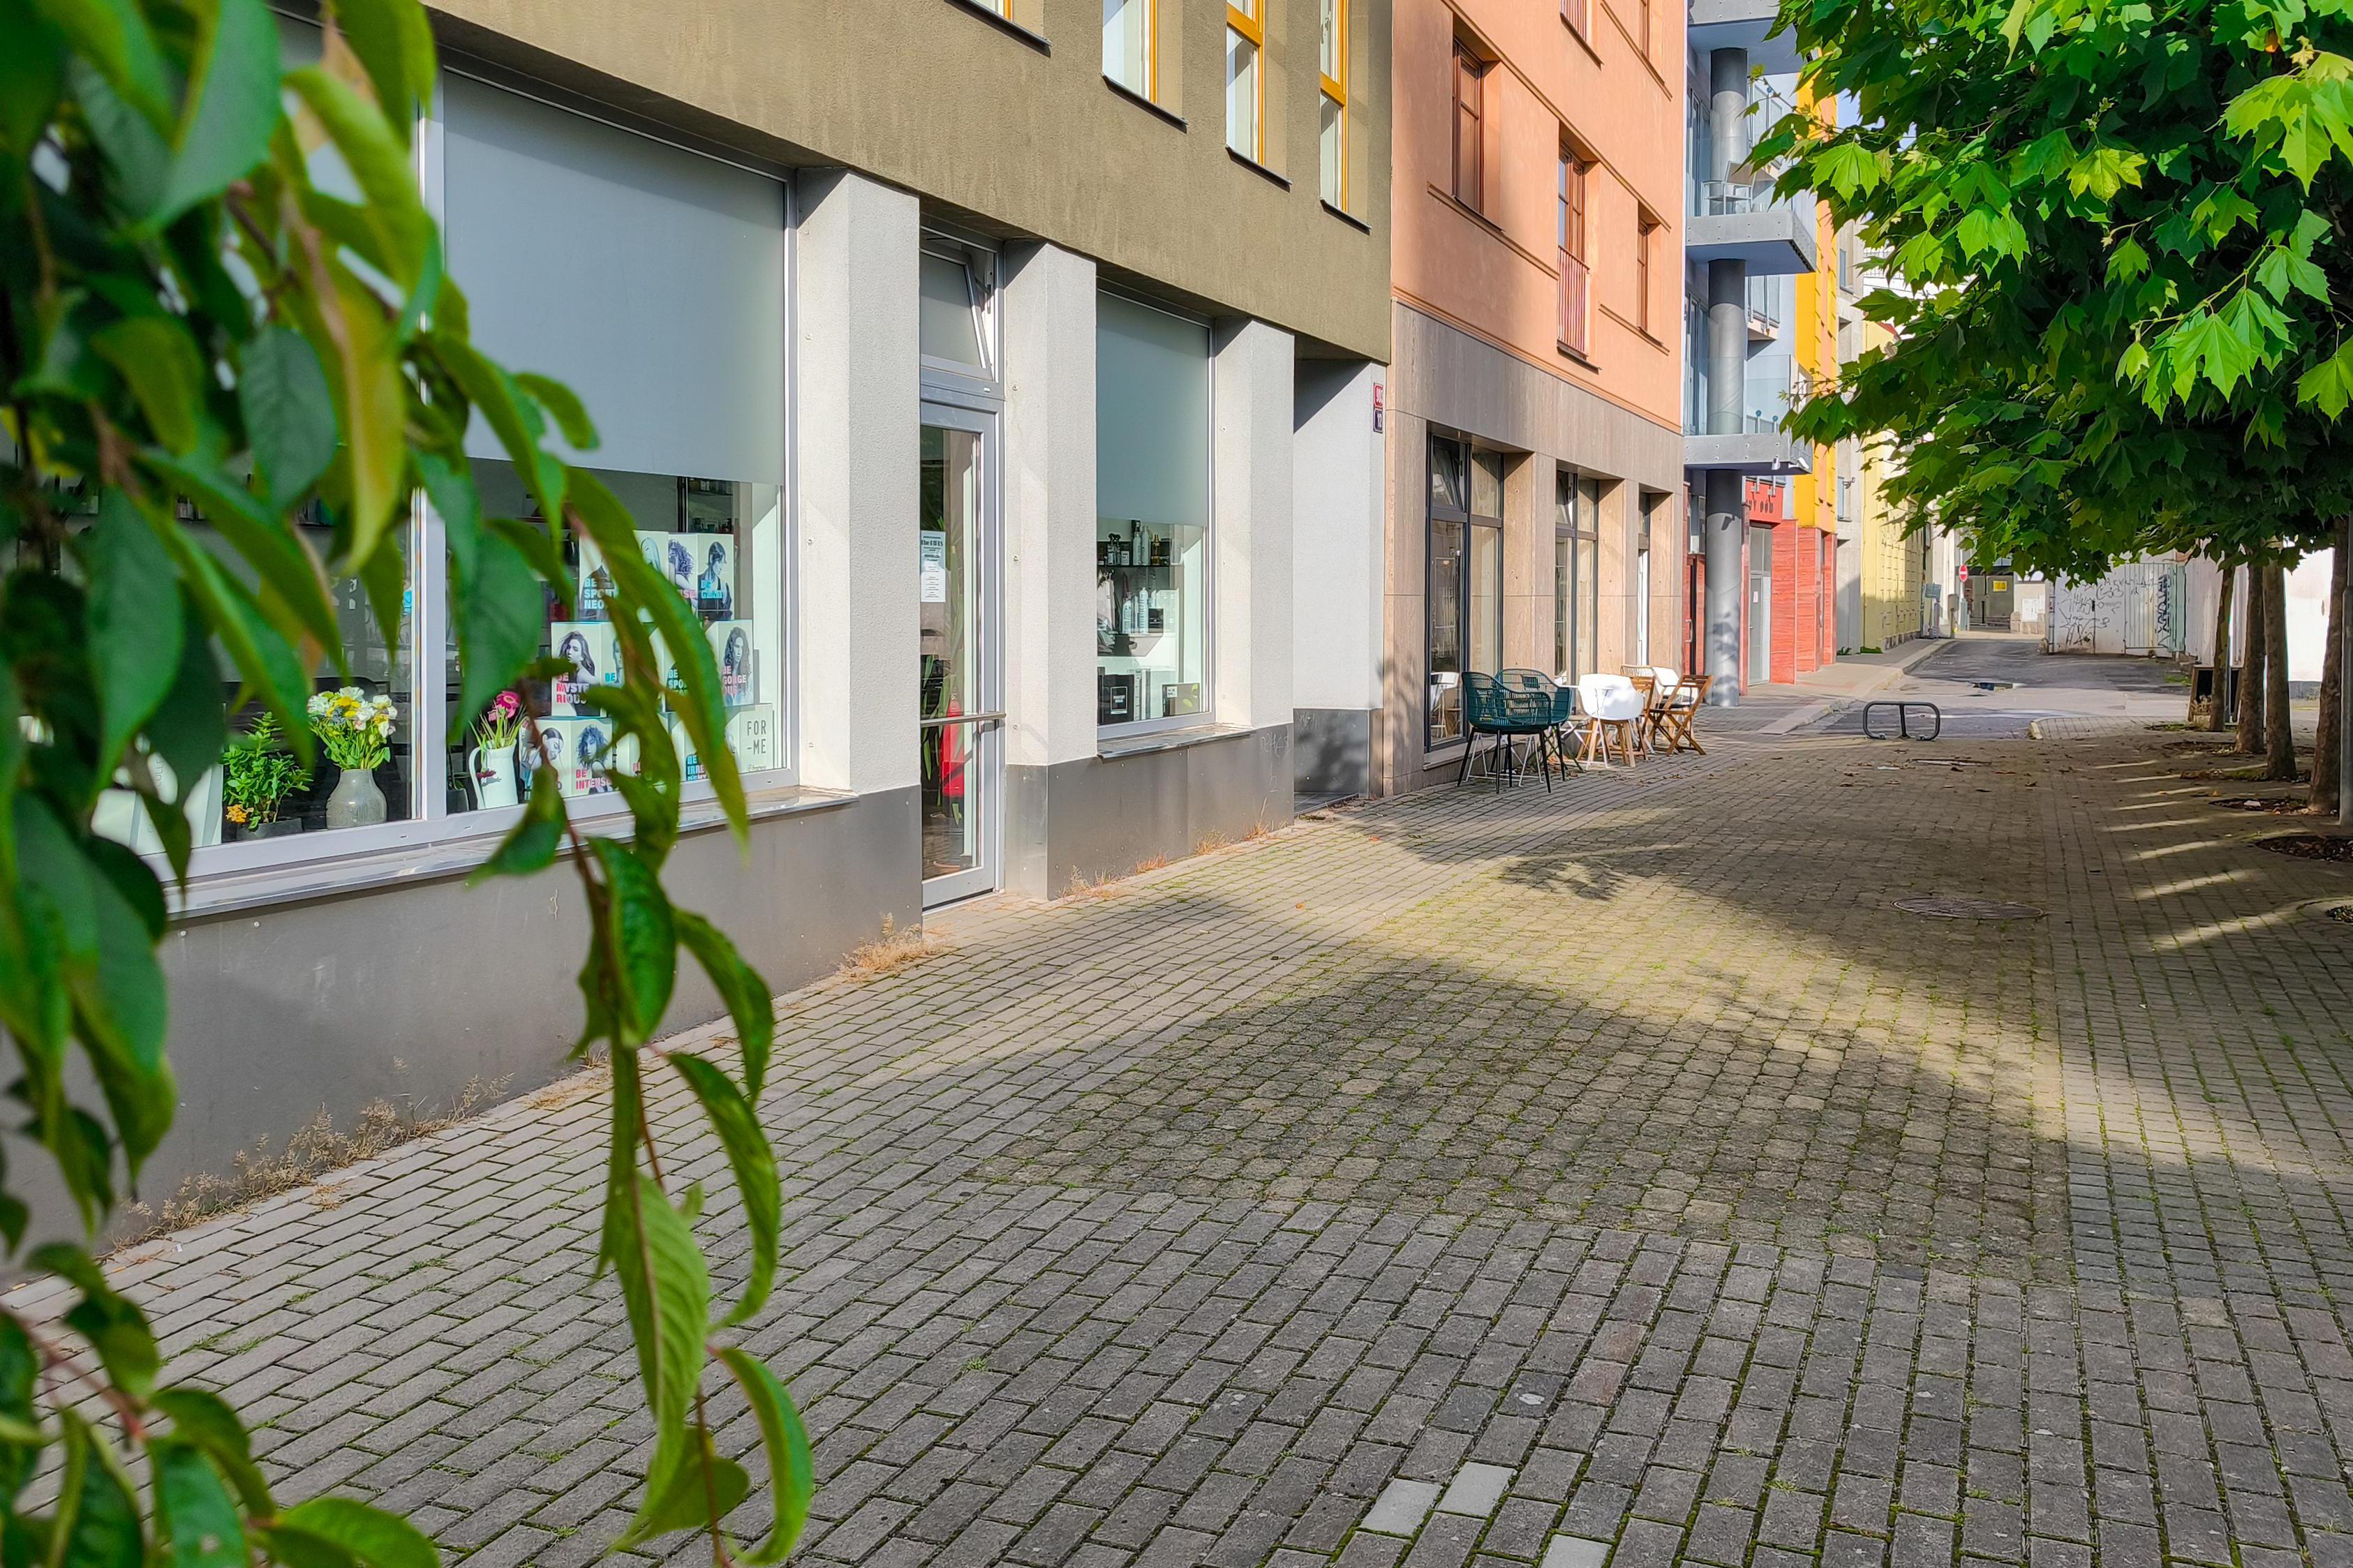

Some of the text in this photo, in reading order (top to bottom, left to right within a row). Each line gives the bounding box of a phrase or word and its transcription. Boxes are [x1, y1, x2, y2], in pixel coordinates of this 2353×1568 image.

[584, 578, 597, 588] BE
[604, 671, 616, 682] BE
[668, 669, 678, 678] BE
[667, 678, 687, 689] SPO
[747, 719, 766, 736] FOR
[687, 754, 698, 765] BE
[575, 769, 587, 779] BE
